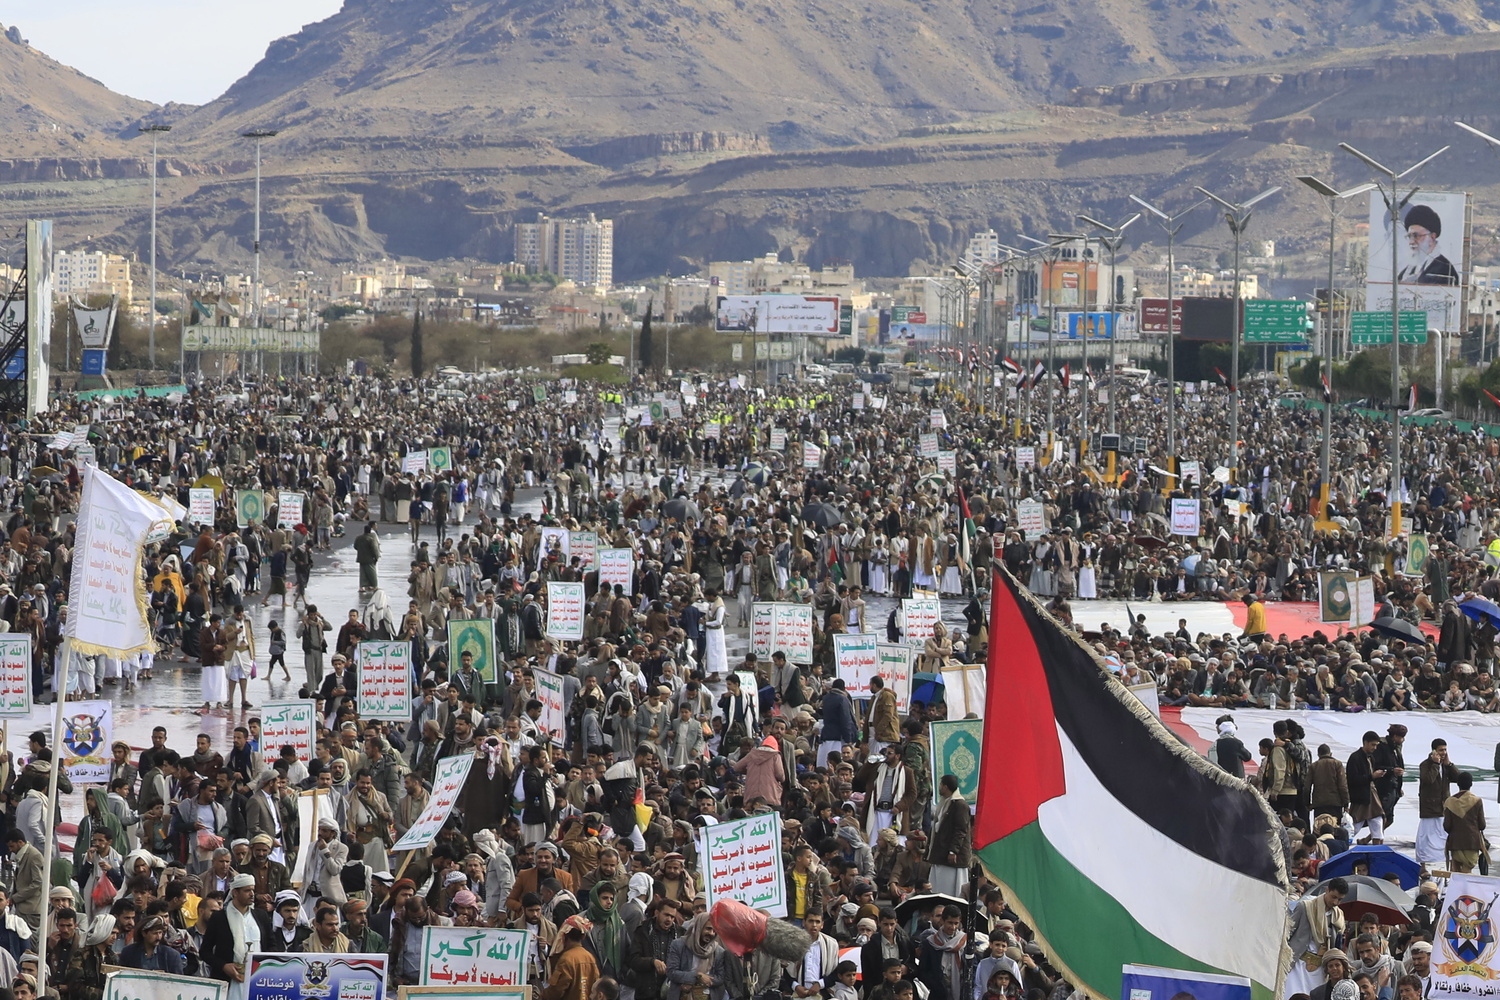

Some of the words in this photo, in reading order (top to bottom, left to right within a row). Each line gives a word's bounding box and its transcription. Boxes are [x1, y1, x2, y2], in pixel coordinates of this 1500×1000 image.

[431, 930, 486, 962] أكبر
[487, 936, 520, 960] الله
[430, 963, 477, 984] لأمريكا
[480, 971, 516, 985] الموت
[256, 978, 295, 991] فوضناك
